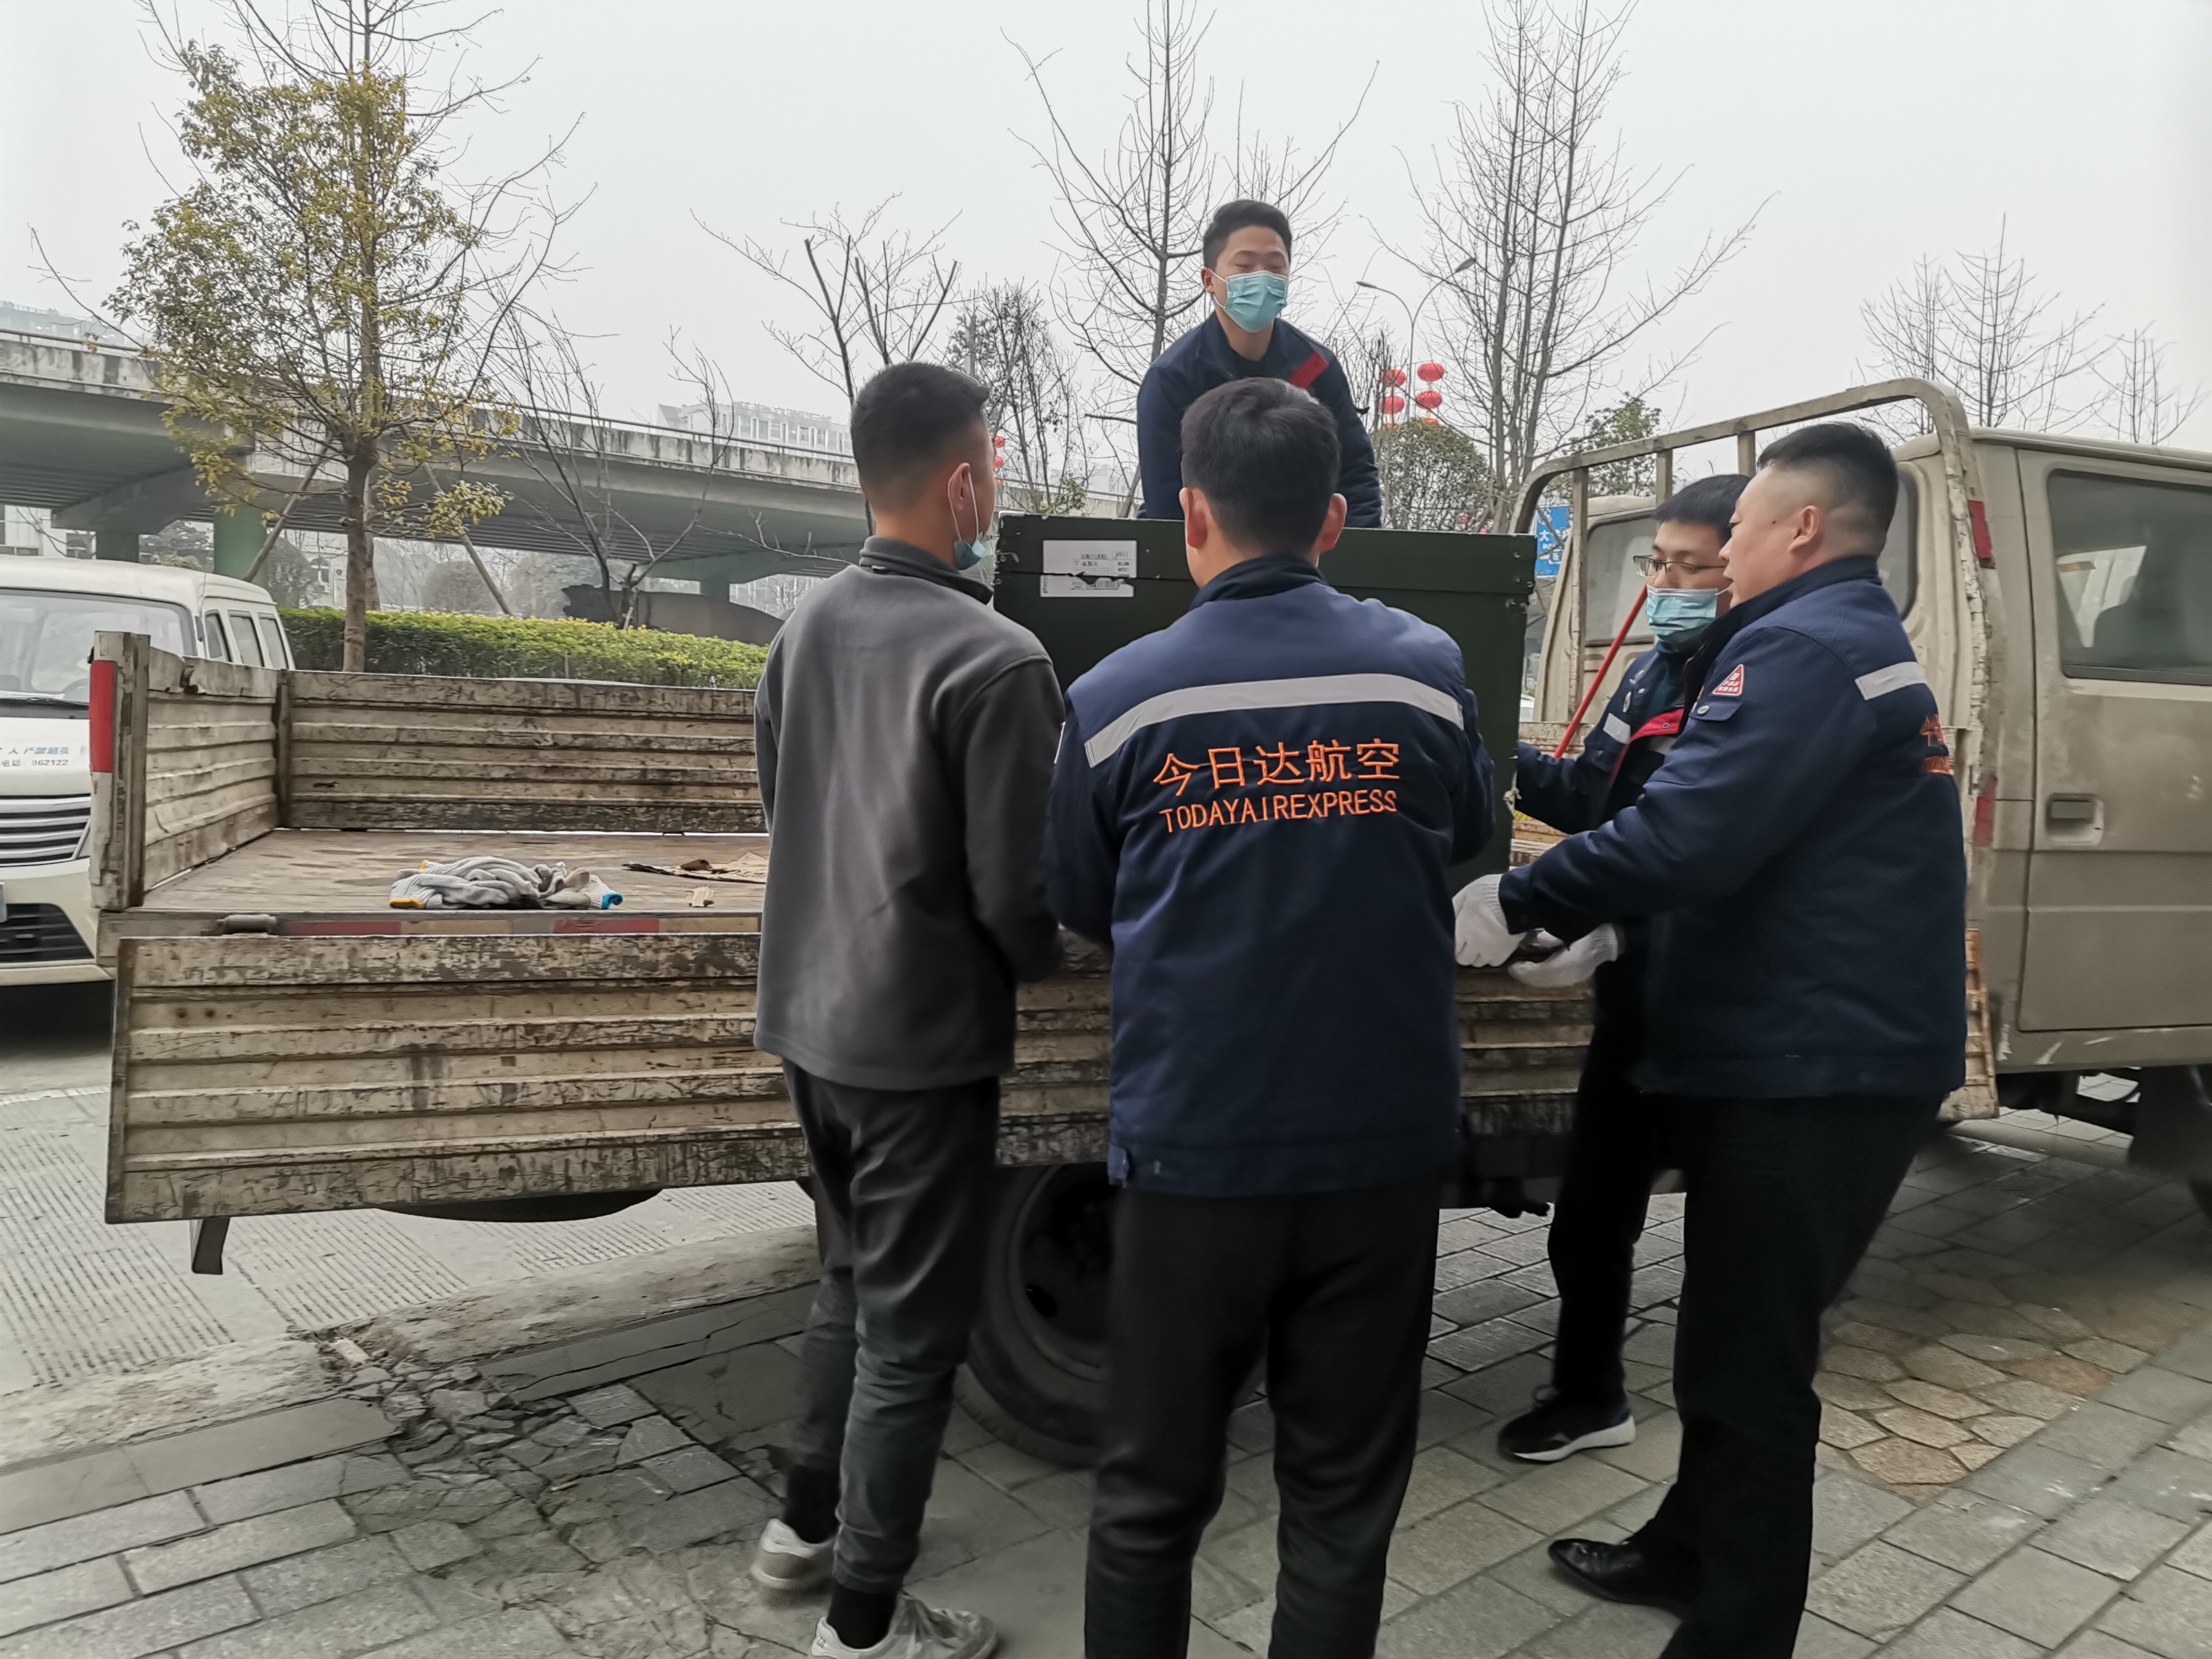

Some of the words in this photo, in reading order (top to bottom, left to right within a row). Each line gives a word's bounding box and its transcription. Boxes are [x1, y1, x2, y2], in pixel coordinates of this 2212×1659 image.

[1153, 738, 1400, 796] 今日达航空
[1159, 789, 1397, 833] TODAYAIREXPRESS
